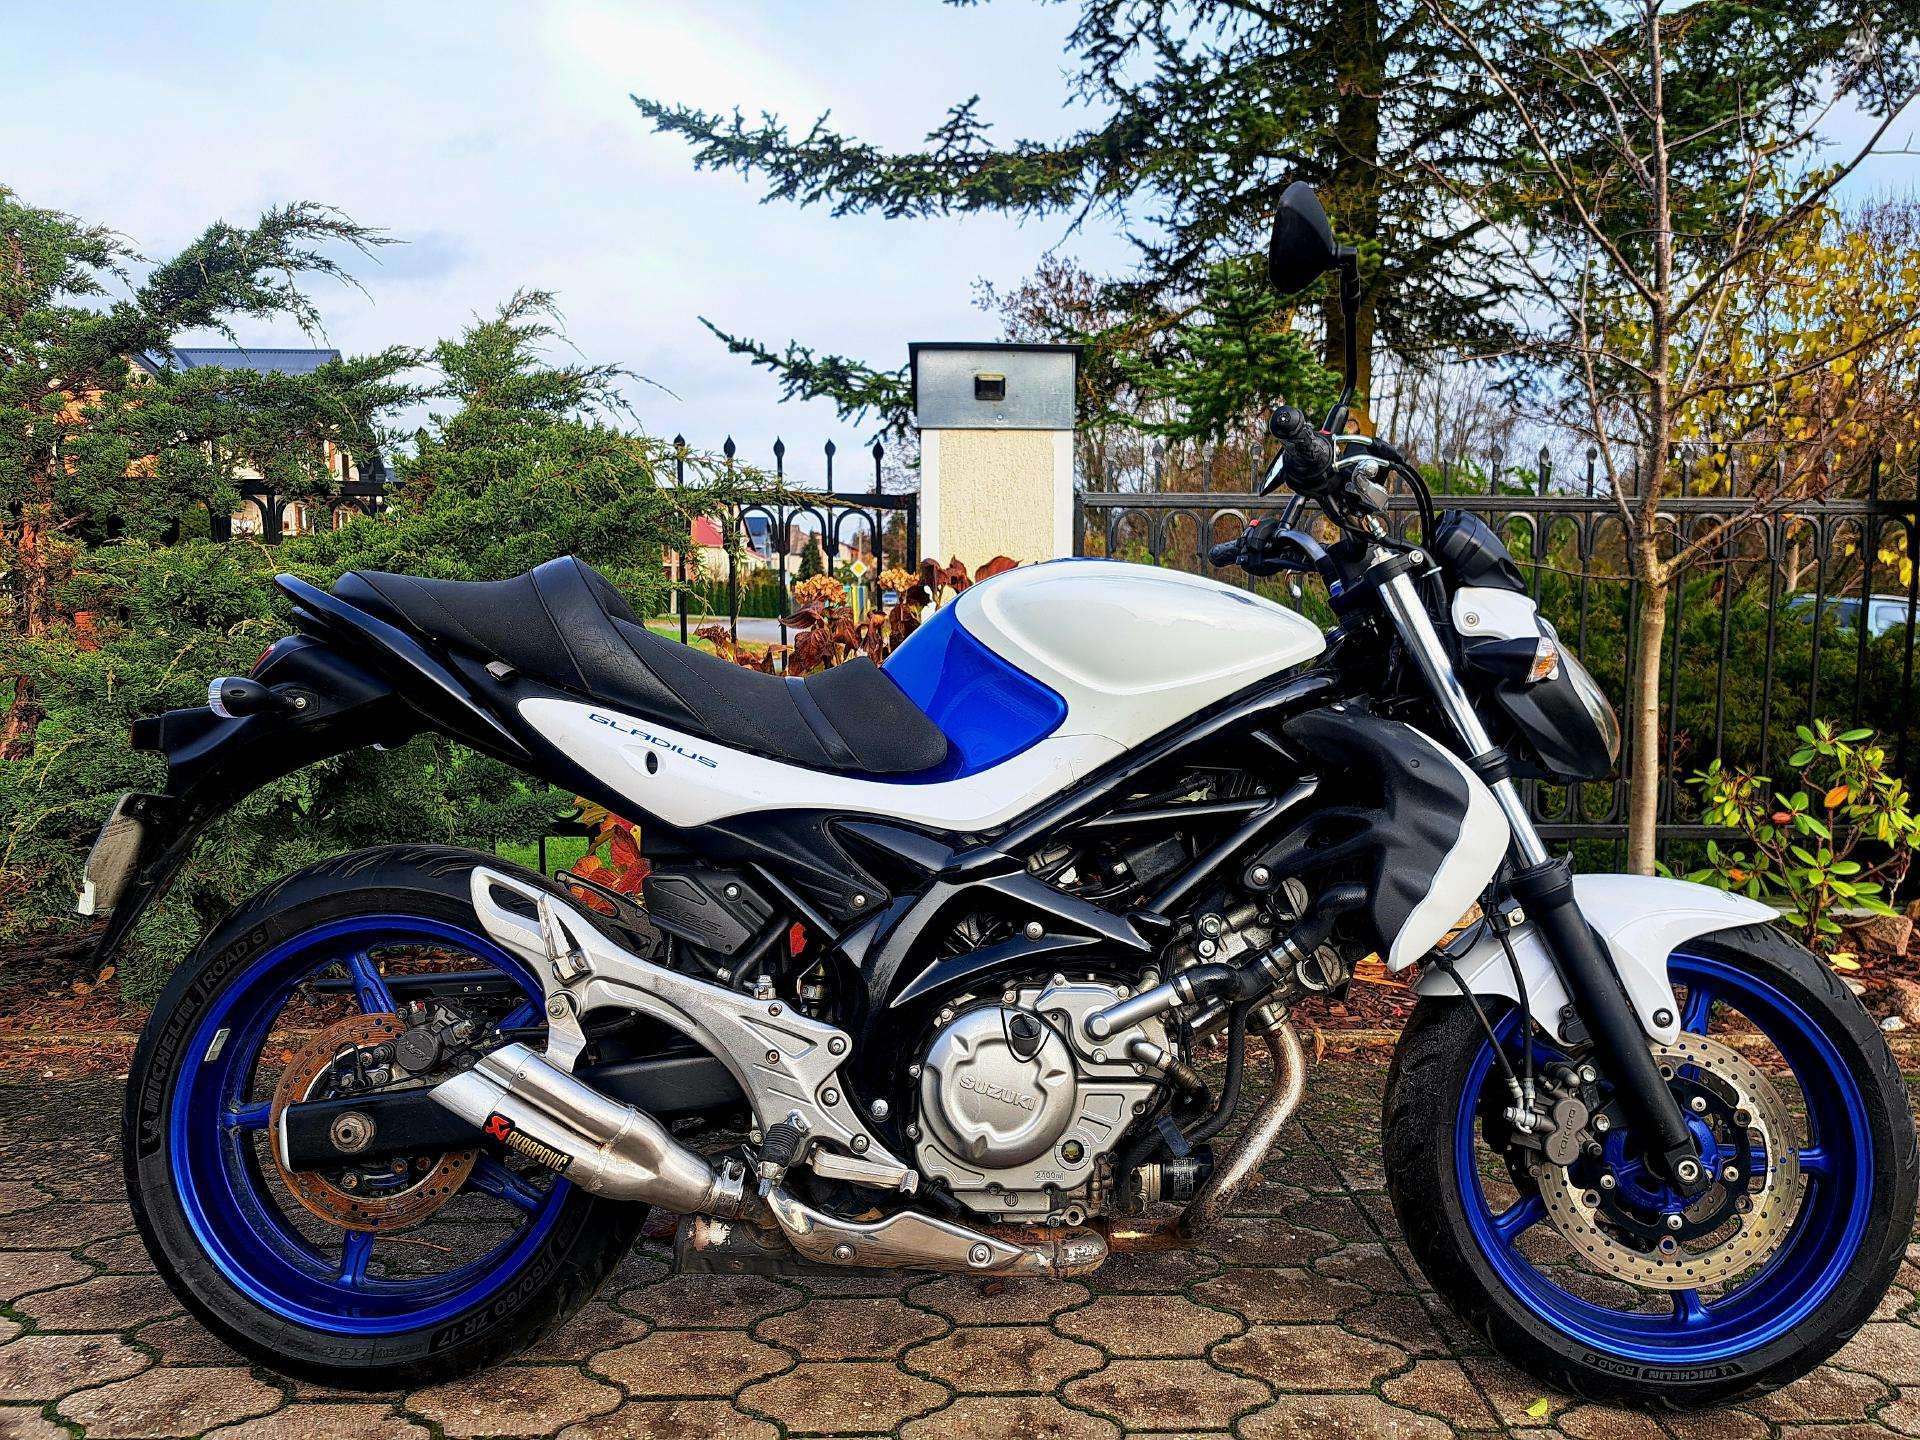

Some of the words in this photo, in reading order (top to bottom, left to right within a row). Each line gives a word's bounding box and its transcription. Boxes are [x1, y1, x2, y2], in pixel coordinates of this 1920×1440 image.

[588, 713, 719, 769] GLADIUS
[143, 997, 200, 1113] MICHELIN
[203, 944, 248, 991] ROAD
[253, 931, 266, 945] 6
[959, 1074, 1037, 1111] SUZUKI
[505, 1131, 570, 1172] AKRAPOVIČ
[464, 1313, 489, 1335] ZR
[438, 1325, 459, 1347] 17
[1586, 1355, 1597, 1363] 6
[1598, 1360, 1634, 1375] ROAD
[1648, 1368, 1717, 1381] MICHELIN
